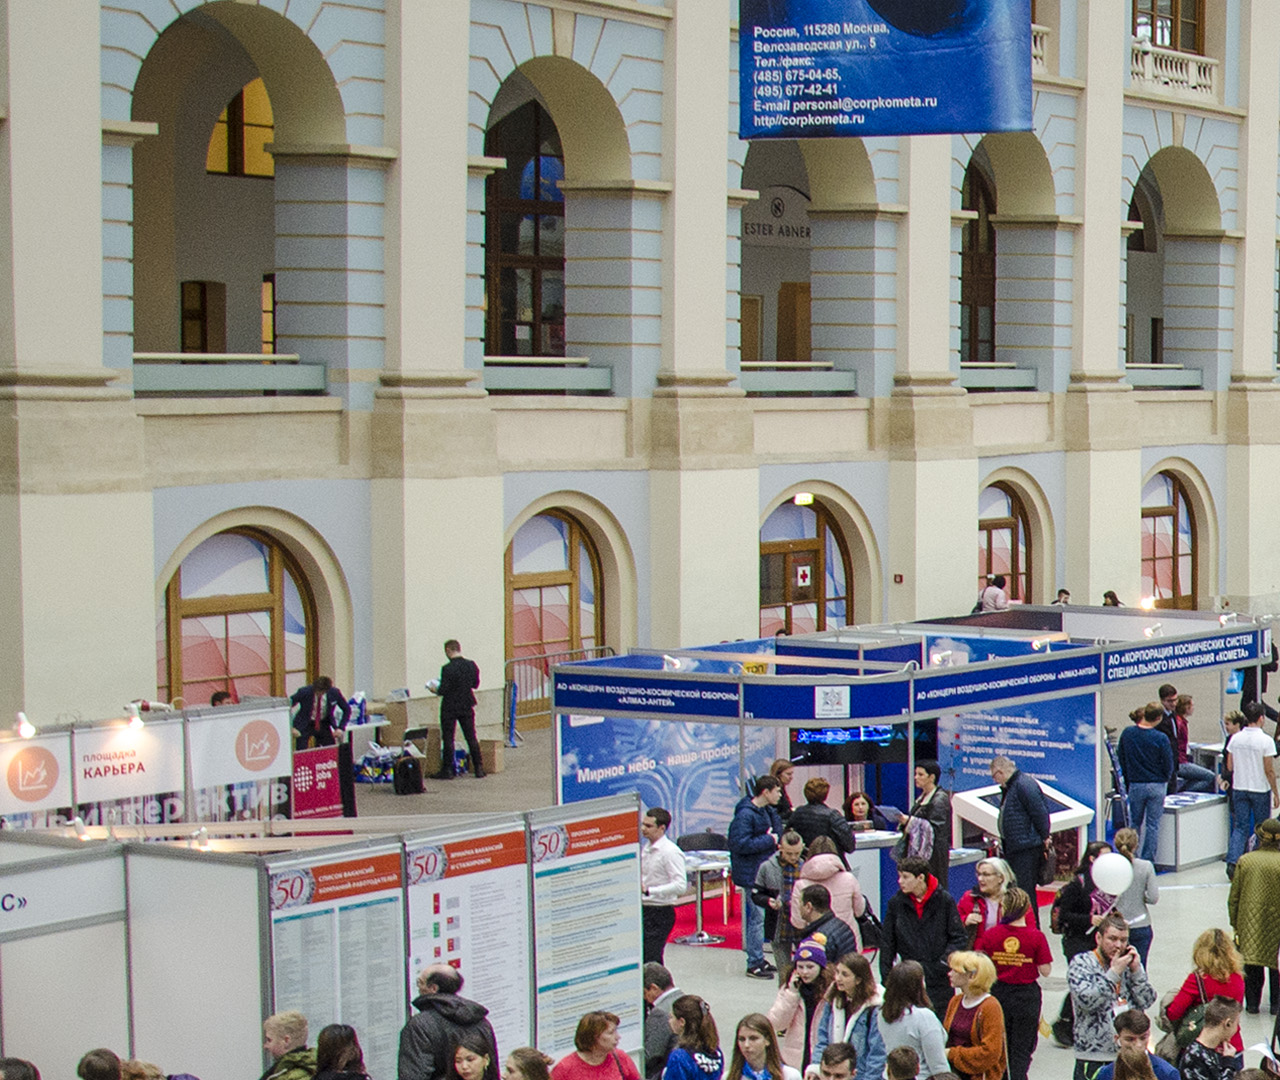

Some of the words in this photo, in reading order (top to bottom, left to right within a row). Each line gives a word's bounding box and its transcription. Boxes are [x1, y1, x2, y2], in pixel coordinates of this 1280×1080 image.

[754, 26, 800, 38] Россия,
[804, 24, 840, 36] 115280
[844, 22, 890, 35] Москва,
[754, 39, 842, 53] Велозаводская
[869, 38, 876, 48] 5
[753, 70, 782, 83] (485)
[785, 68, 841, 82] 675-04-65,
[753, 84, 782, 98] (495)
[785, 83, 838, 96] 677-42-41
[754, 99, 790, 112] E-mail
[792, 96, 937, 114] personal@corpkometa.ru
[83, 762, 146, 780] КАРЬЕРА
[577, 766, 625, 784] Мирное
[627, 758, 656, 773] небо
[536, 833, 560, 859] 50
[411, 850, 439, 883] 50
[273, 875, 304, 910] 50
